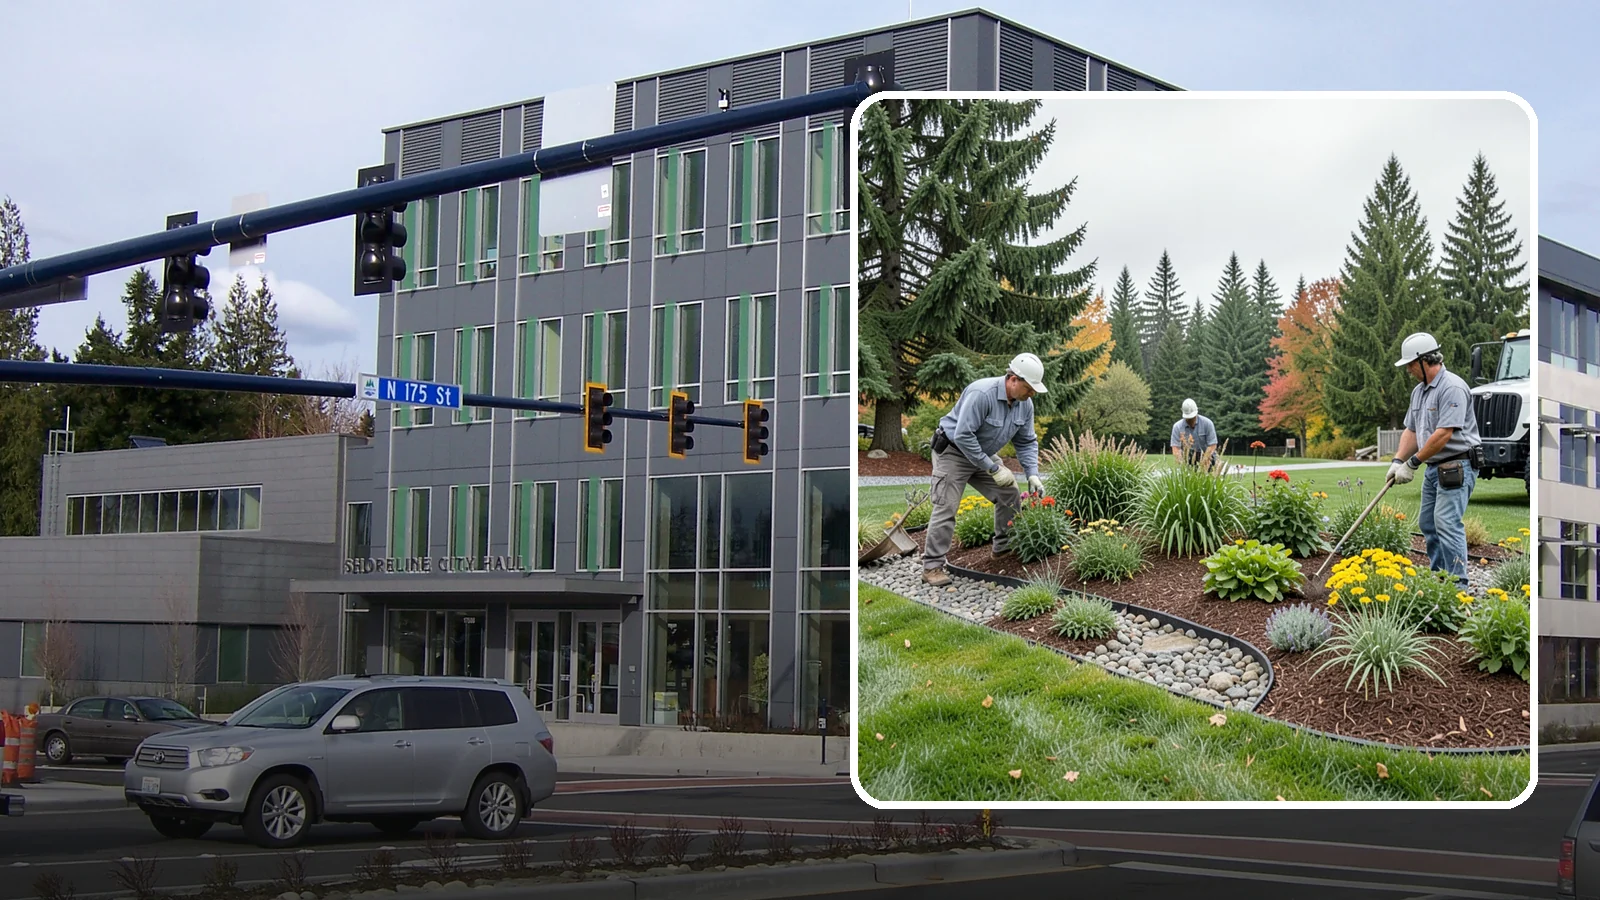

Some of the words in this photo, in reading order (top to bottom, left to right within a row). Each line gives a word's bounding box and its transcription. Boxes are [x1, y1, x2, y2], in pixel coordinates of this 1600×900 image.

[387, 380, 396, 400] N
[405, 382, 427, 403] 175
[436, 386, 451, 406] St
[343, 557, 432, 574] SHORELINE
[438, 556, 477, 572] CITY
[484, 555, 525, 571] HALL
